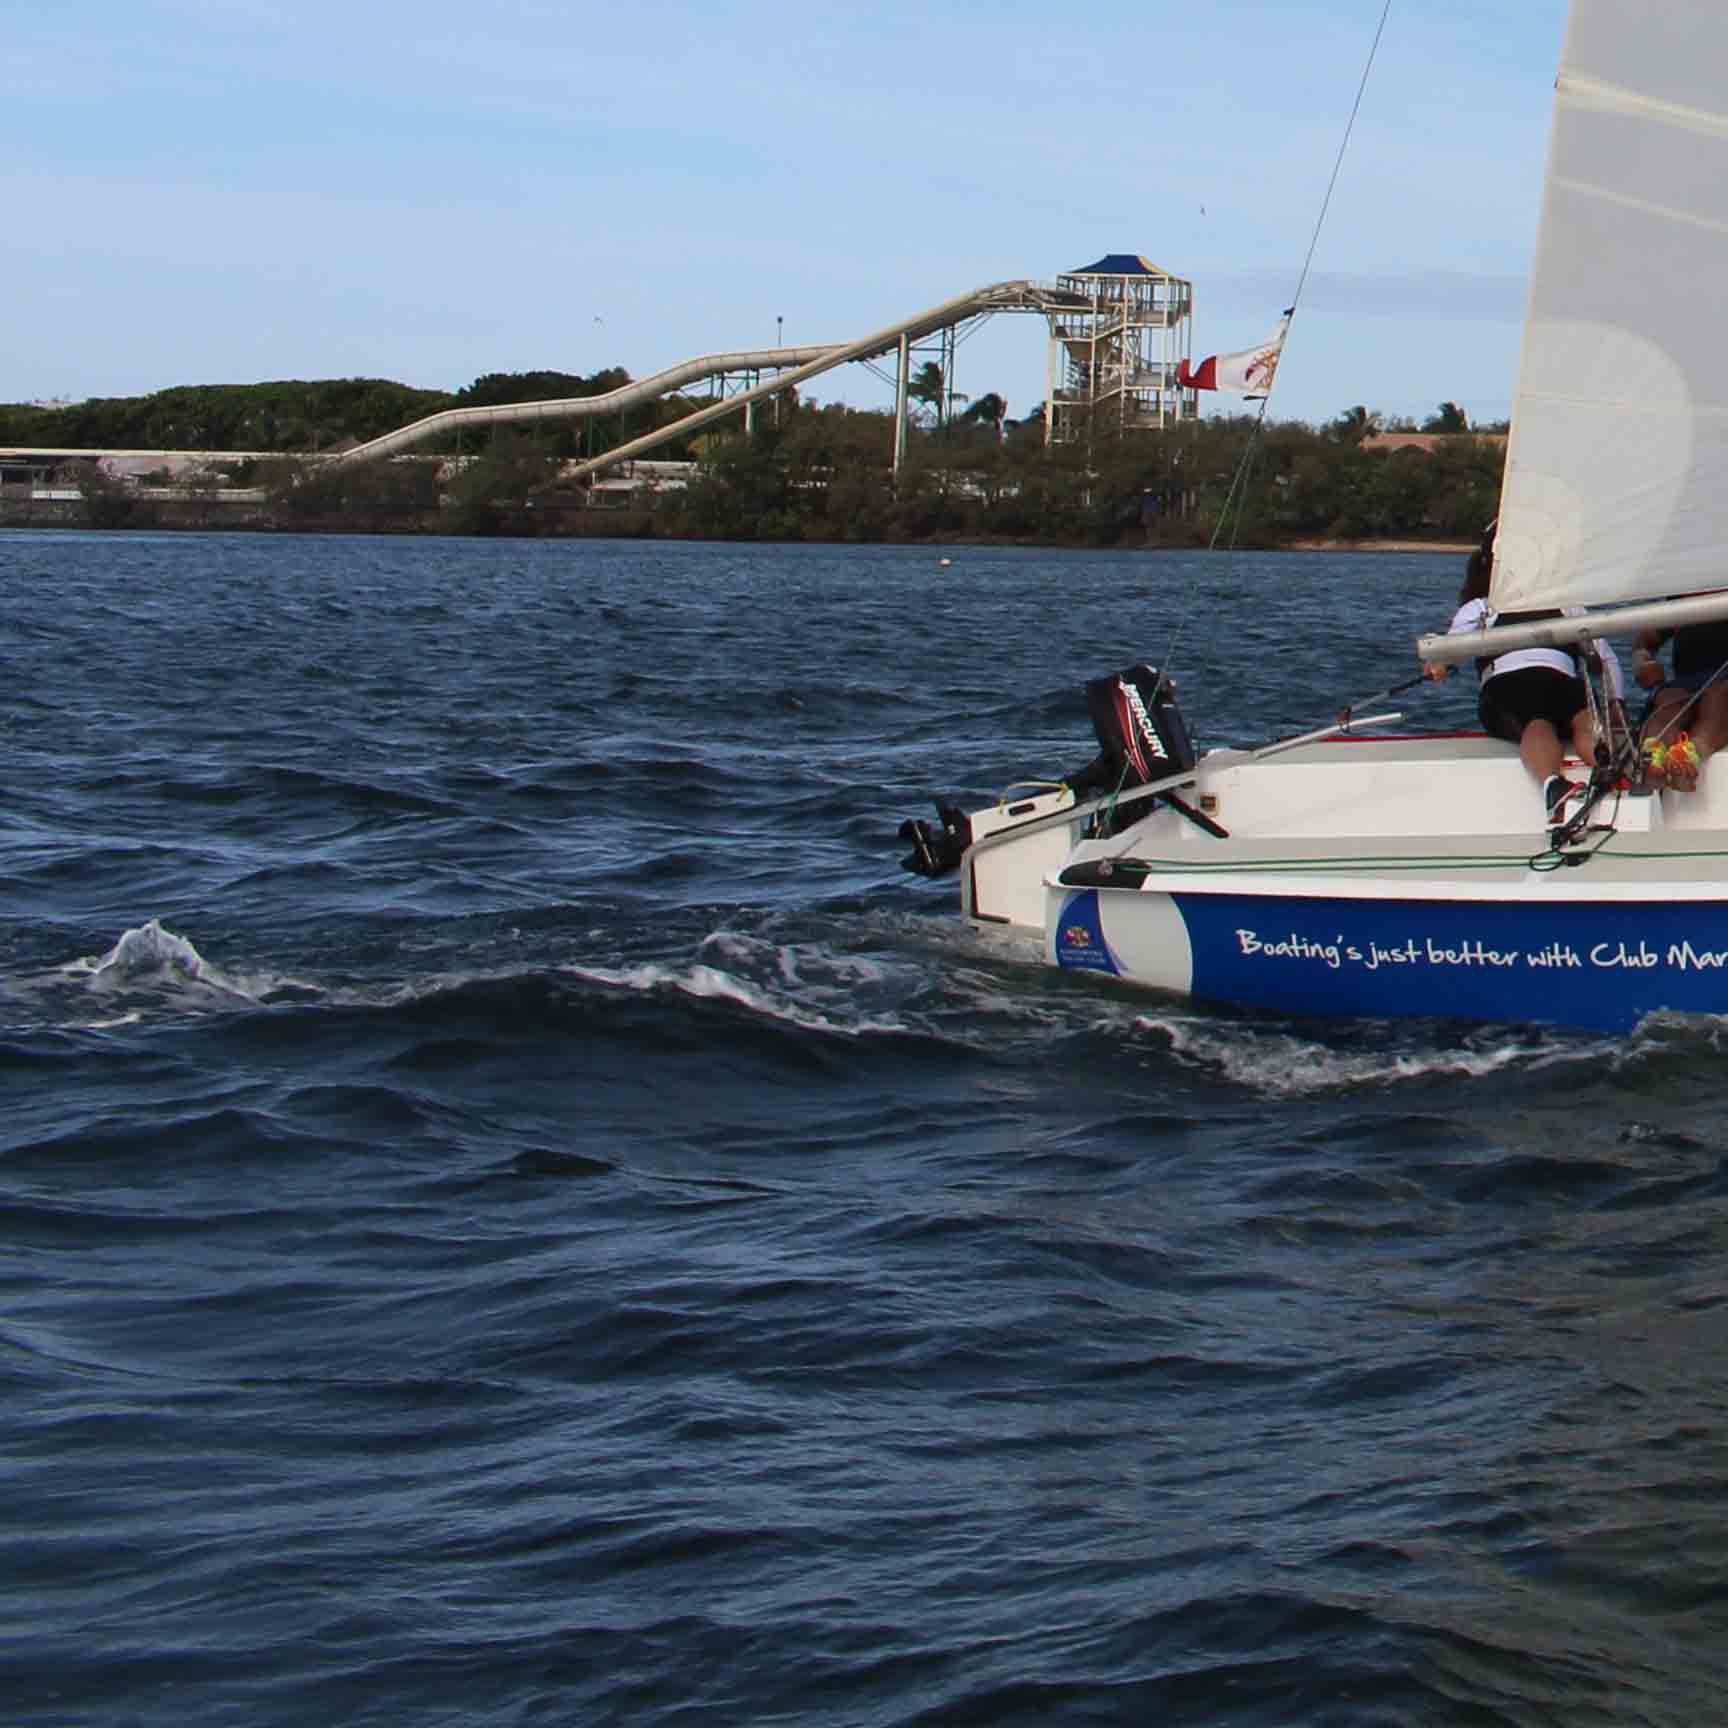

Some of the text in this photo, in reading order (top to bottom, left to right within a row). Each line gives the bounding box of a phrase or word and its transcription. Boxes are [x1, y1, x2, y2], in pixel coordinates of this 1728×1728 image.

[1118, 679, 1168, 759] MERCURY
[1235, 928, 1363, 968] Boating's
[1364, 939, 1422, 969] just
[1426, 938, 1518, 966] better
[1527, 942, 1582, 967] with
[1590, 940, 1658, 968] Club
